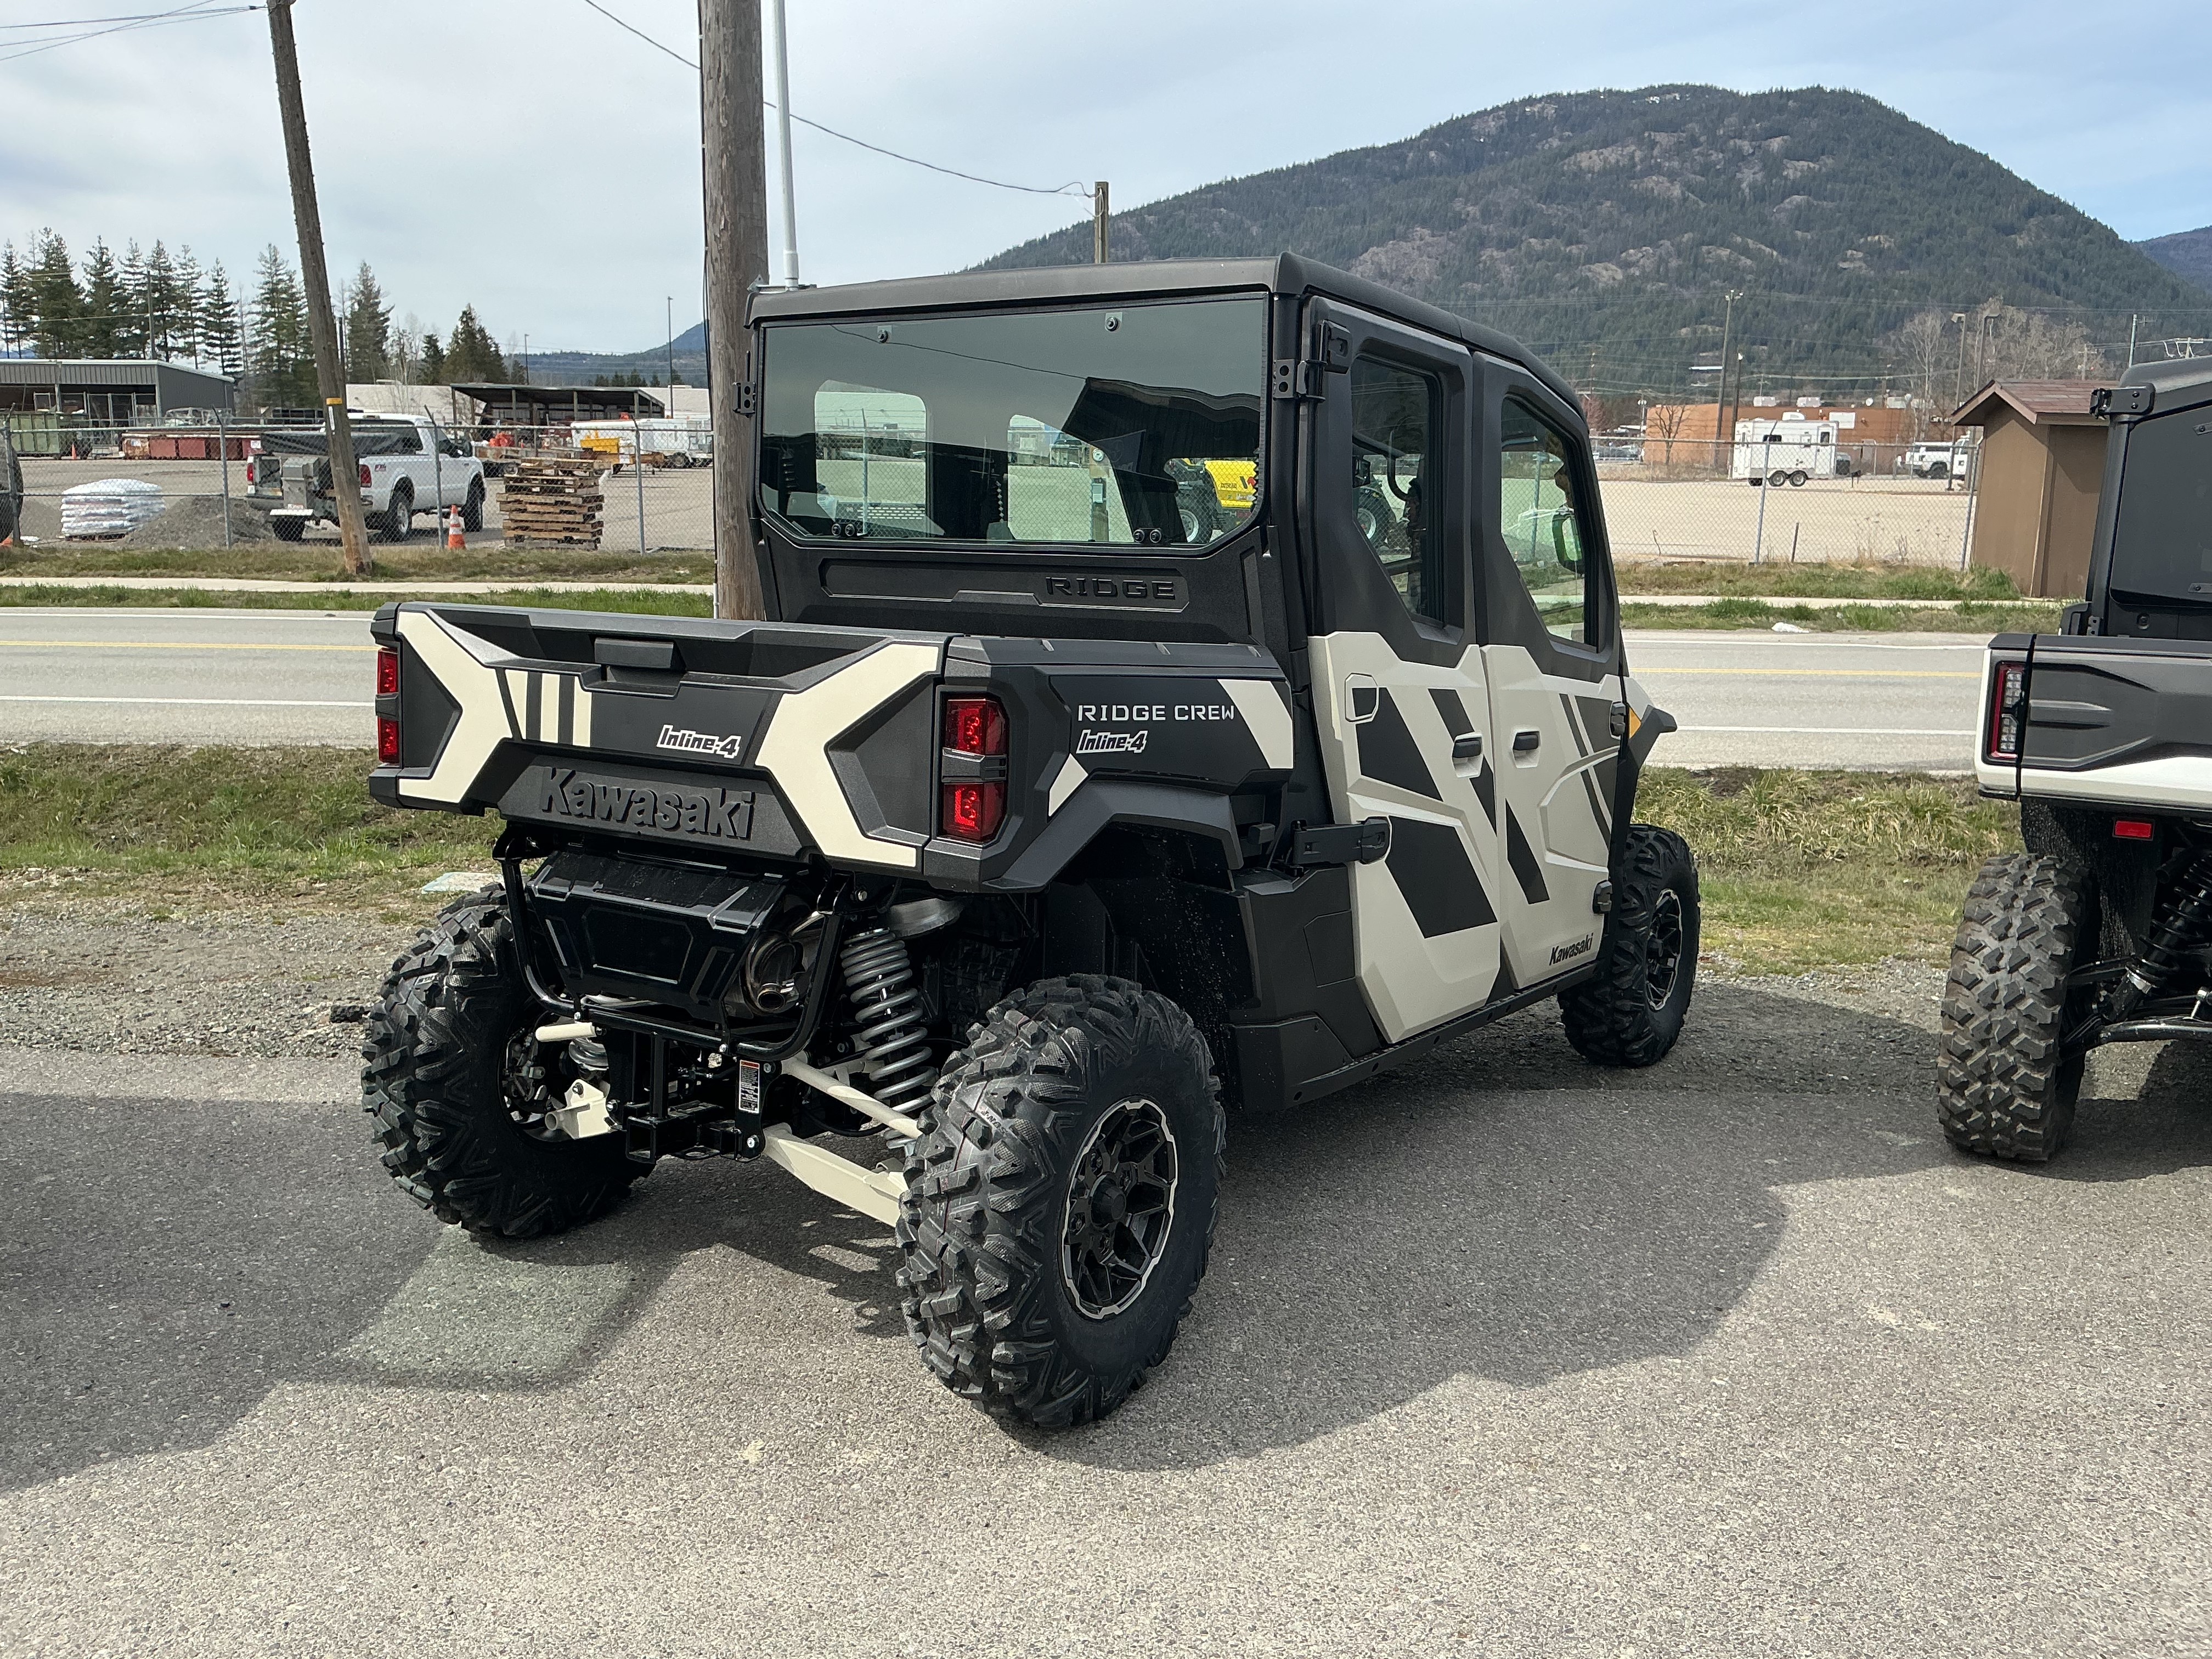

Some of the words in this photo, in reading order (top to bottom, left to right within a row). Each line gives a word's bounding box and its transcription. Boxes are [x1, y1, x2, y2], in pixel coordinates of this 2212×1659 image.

[1045, 577, 1175, 600] RIDGE
[1077, 705, 1166, 721] RIDGE
[1174, 705, 1234, 720] CREW
[656, 724, 742, 759] Inline-4
[1075, 729, 1148, 754] Inline-4
[541, 767, 755, 841] Kawasaki
[1549, 932, 1594, 966] Kawasaki
